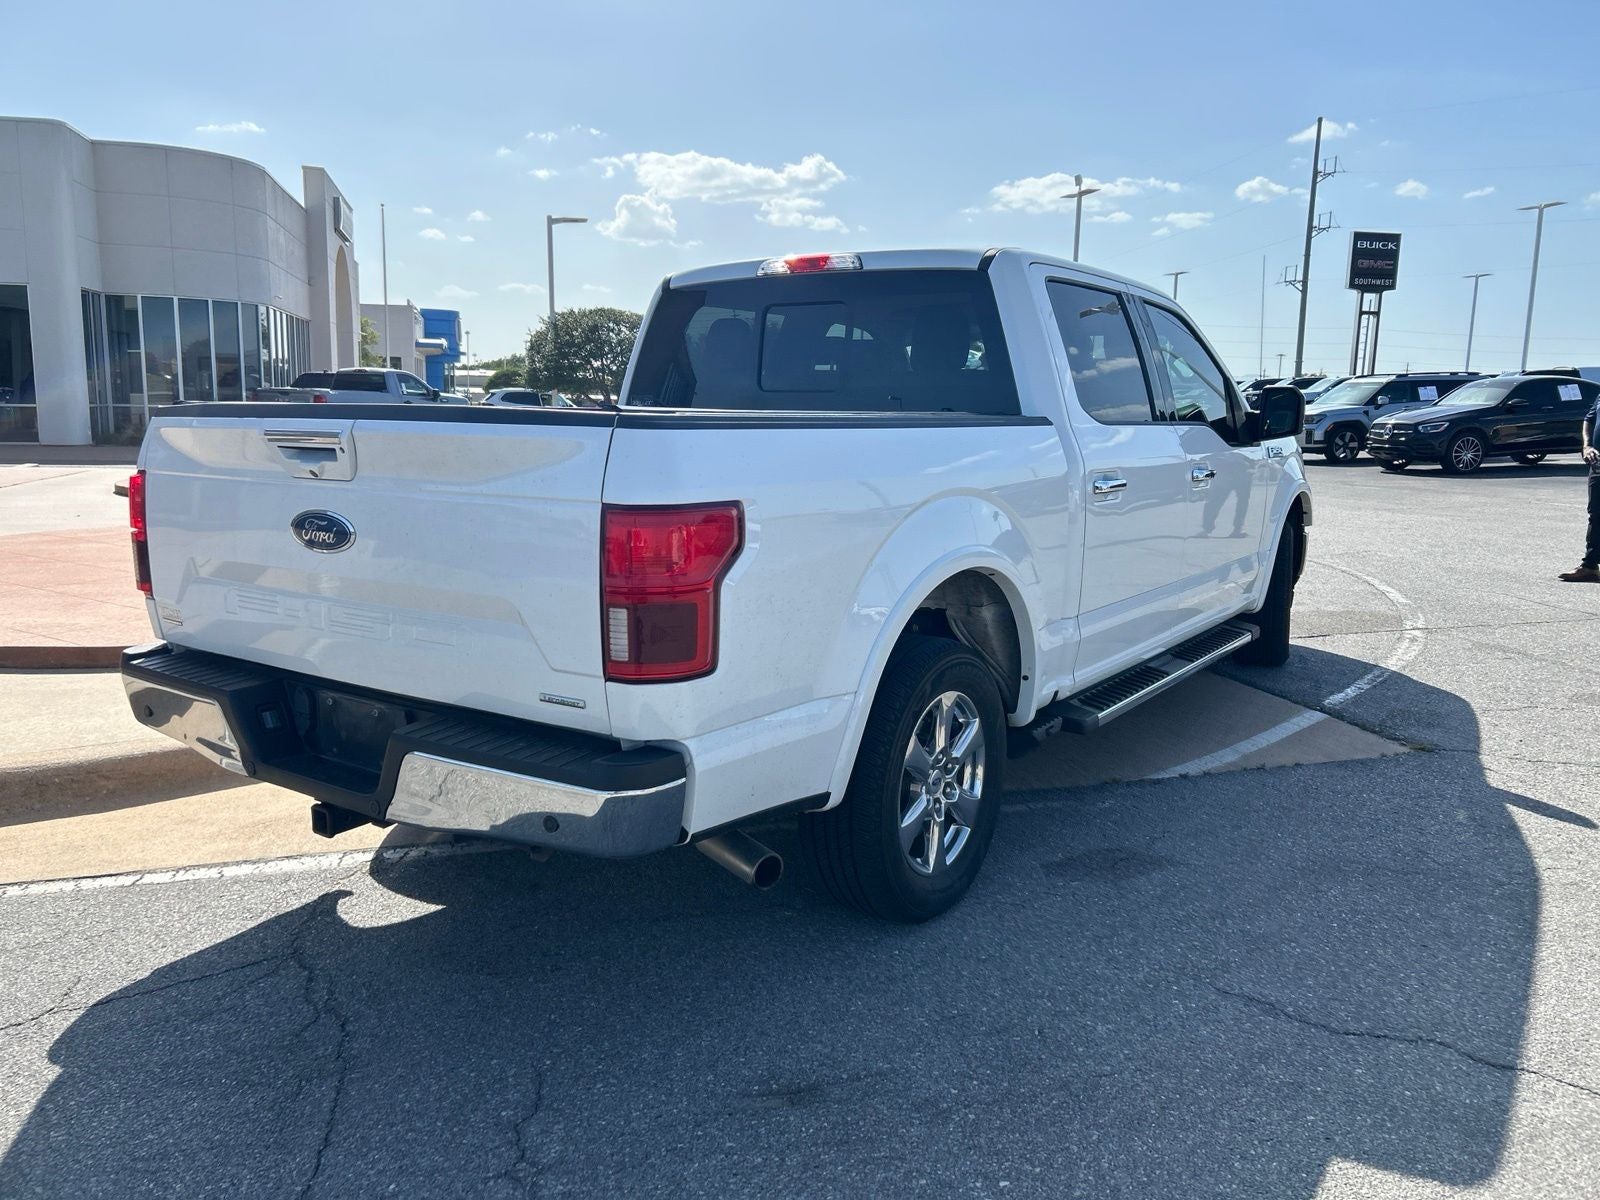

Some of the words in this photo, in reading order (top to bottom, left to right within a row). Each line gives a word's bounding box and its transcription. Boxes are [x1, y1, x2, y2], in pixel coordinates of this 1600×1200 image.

[1357, 240, 1397, 249] BUICK
[1358, 259, 1394, 269] GMC
[1354, 277, 1393, 286] SOUTHWEST
[302, 518, 337, 544] Ford
